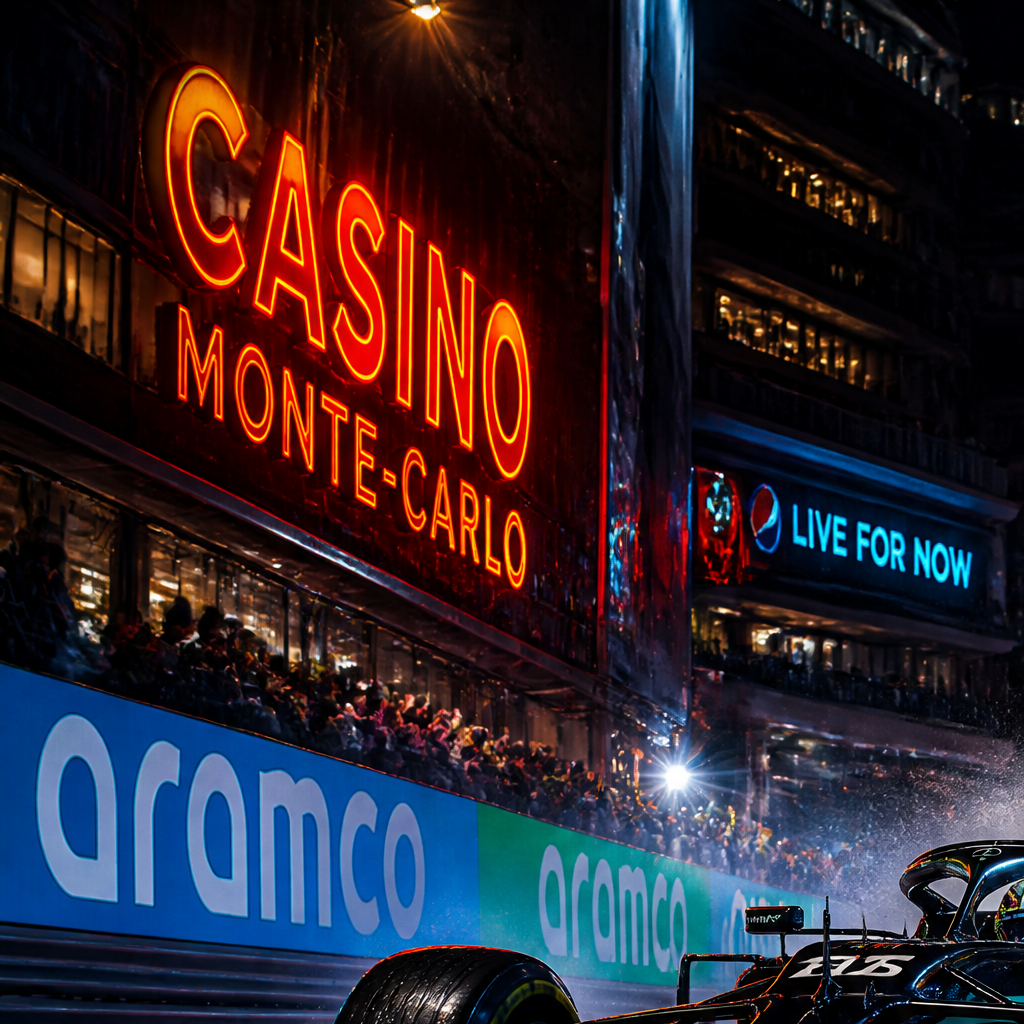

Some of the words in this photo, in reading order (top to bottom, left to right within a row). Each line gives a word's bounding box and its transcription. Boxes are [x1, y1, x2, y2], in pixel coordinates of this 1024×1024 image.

[163, 63, 532, 481] CASINO
[175, 302, 528, 591] MONTE-CARLO
[792, 503, 848, 558] LIVE
[856, 521, 906, 573] FOR
[913, 536, 974, 590] NOW
[36, 712, 427, 941] aramco
[538, 843, 690, 974] aramco
